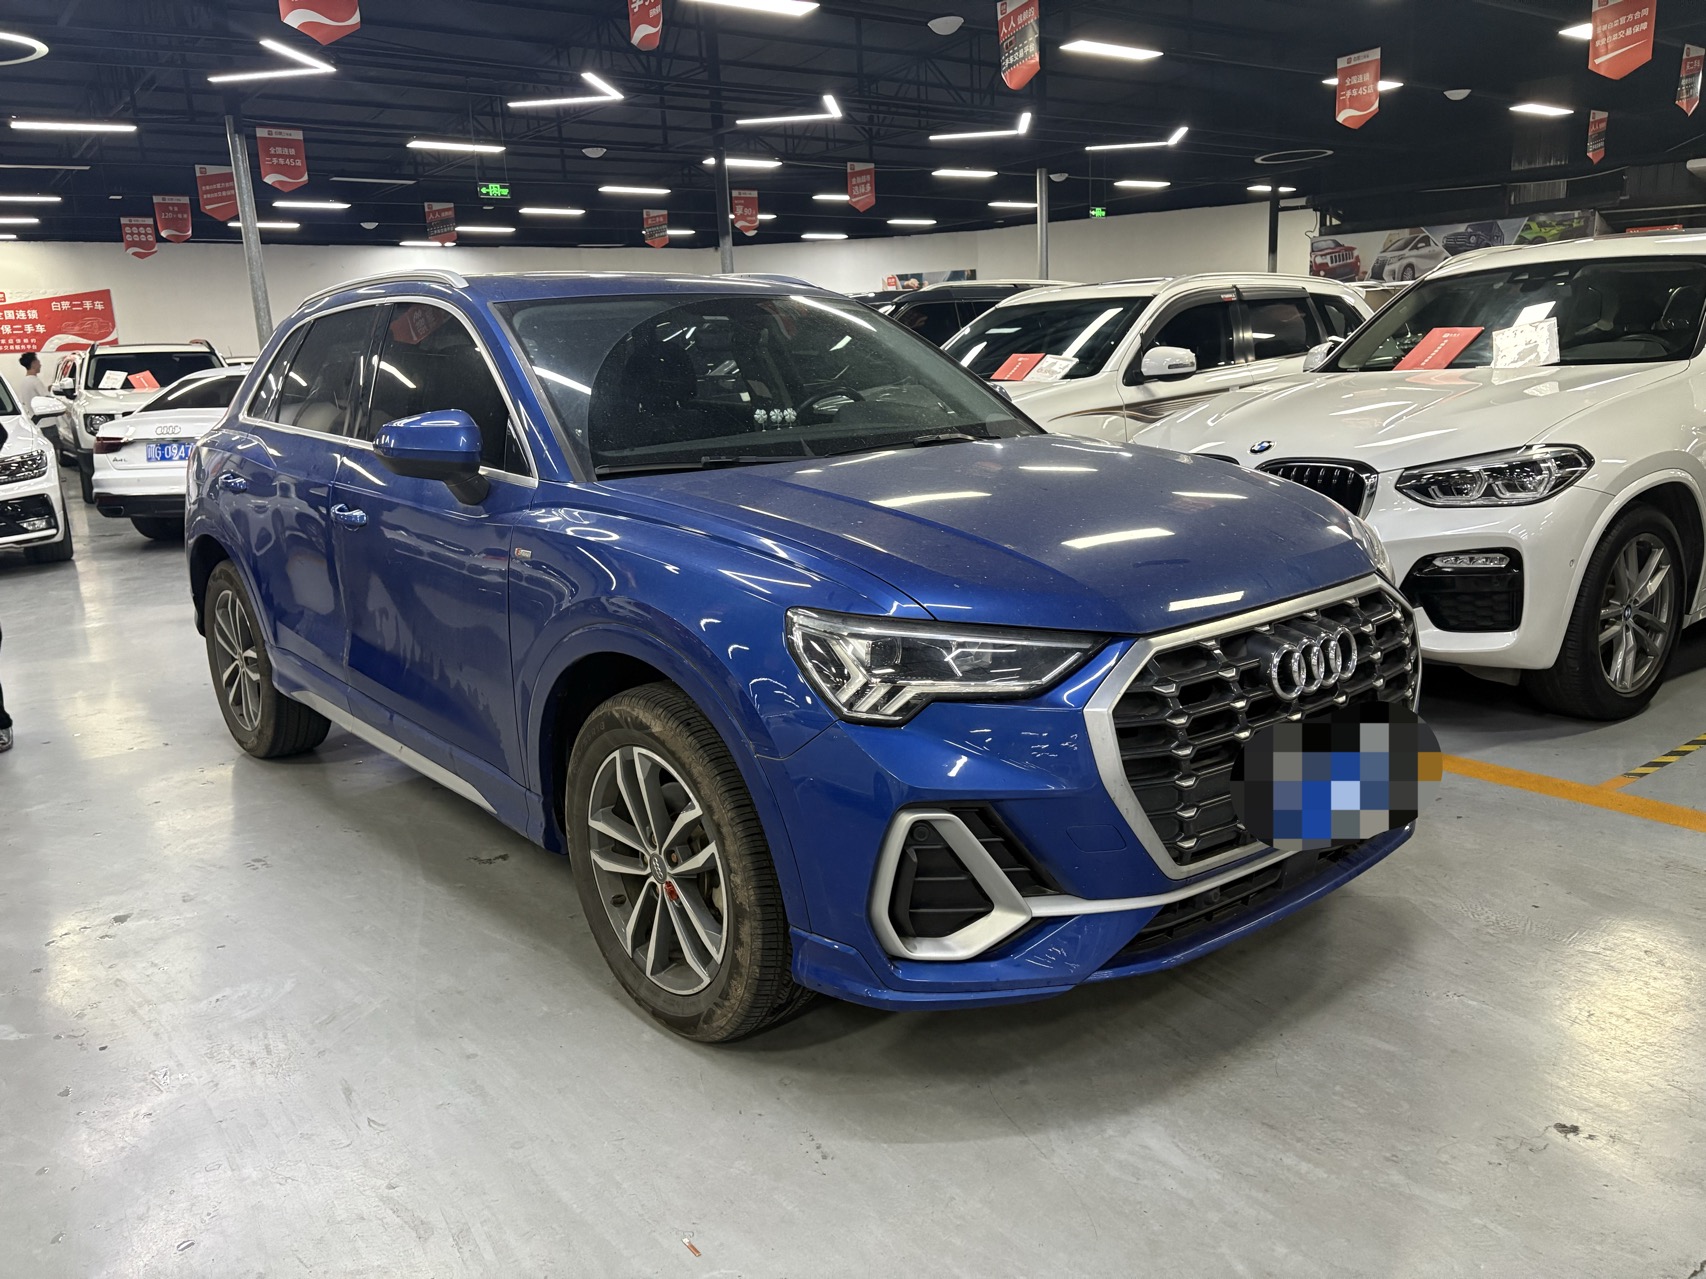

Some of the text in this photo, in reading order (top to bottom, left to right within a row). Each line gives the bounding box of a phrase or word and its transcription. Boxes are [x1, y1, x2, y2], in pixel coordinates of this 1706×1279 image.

[1002, 43, 1035, 71] 二手车交易平台
[1345, 72, 1370, 86] 全国连锁
[1340, 84, 1374, 99] 二手车4S店
[269, 146, 295, 155] 全国连锁
[265, 157, 302, 166] 二手车4S店
[51, 300, 105, 311] 白菜二手车
